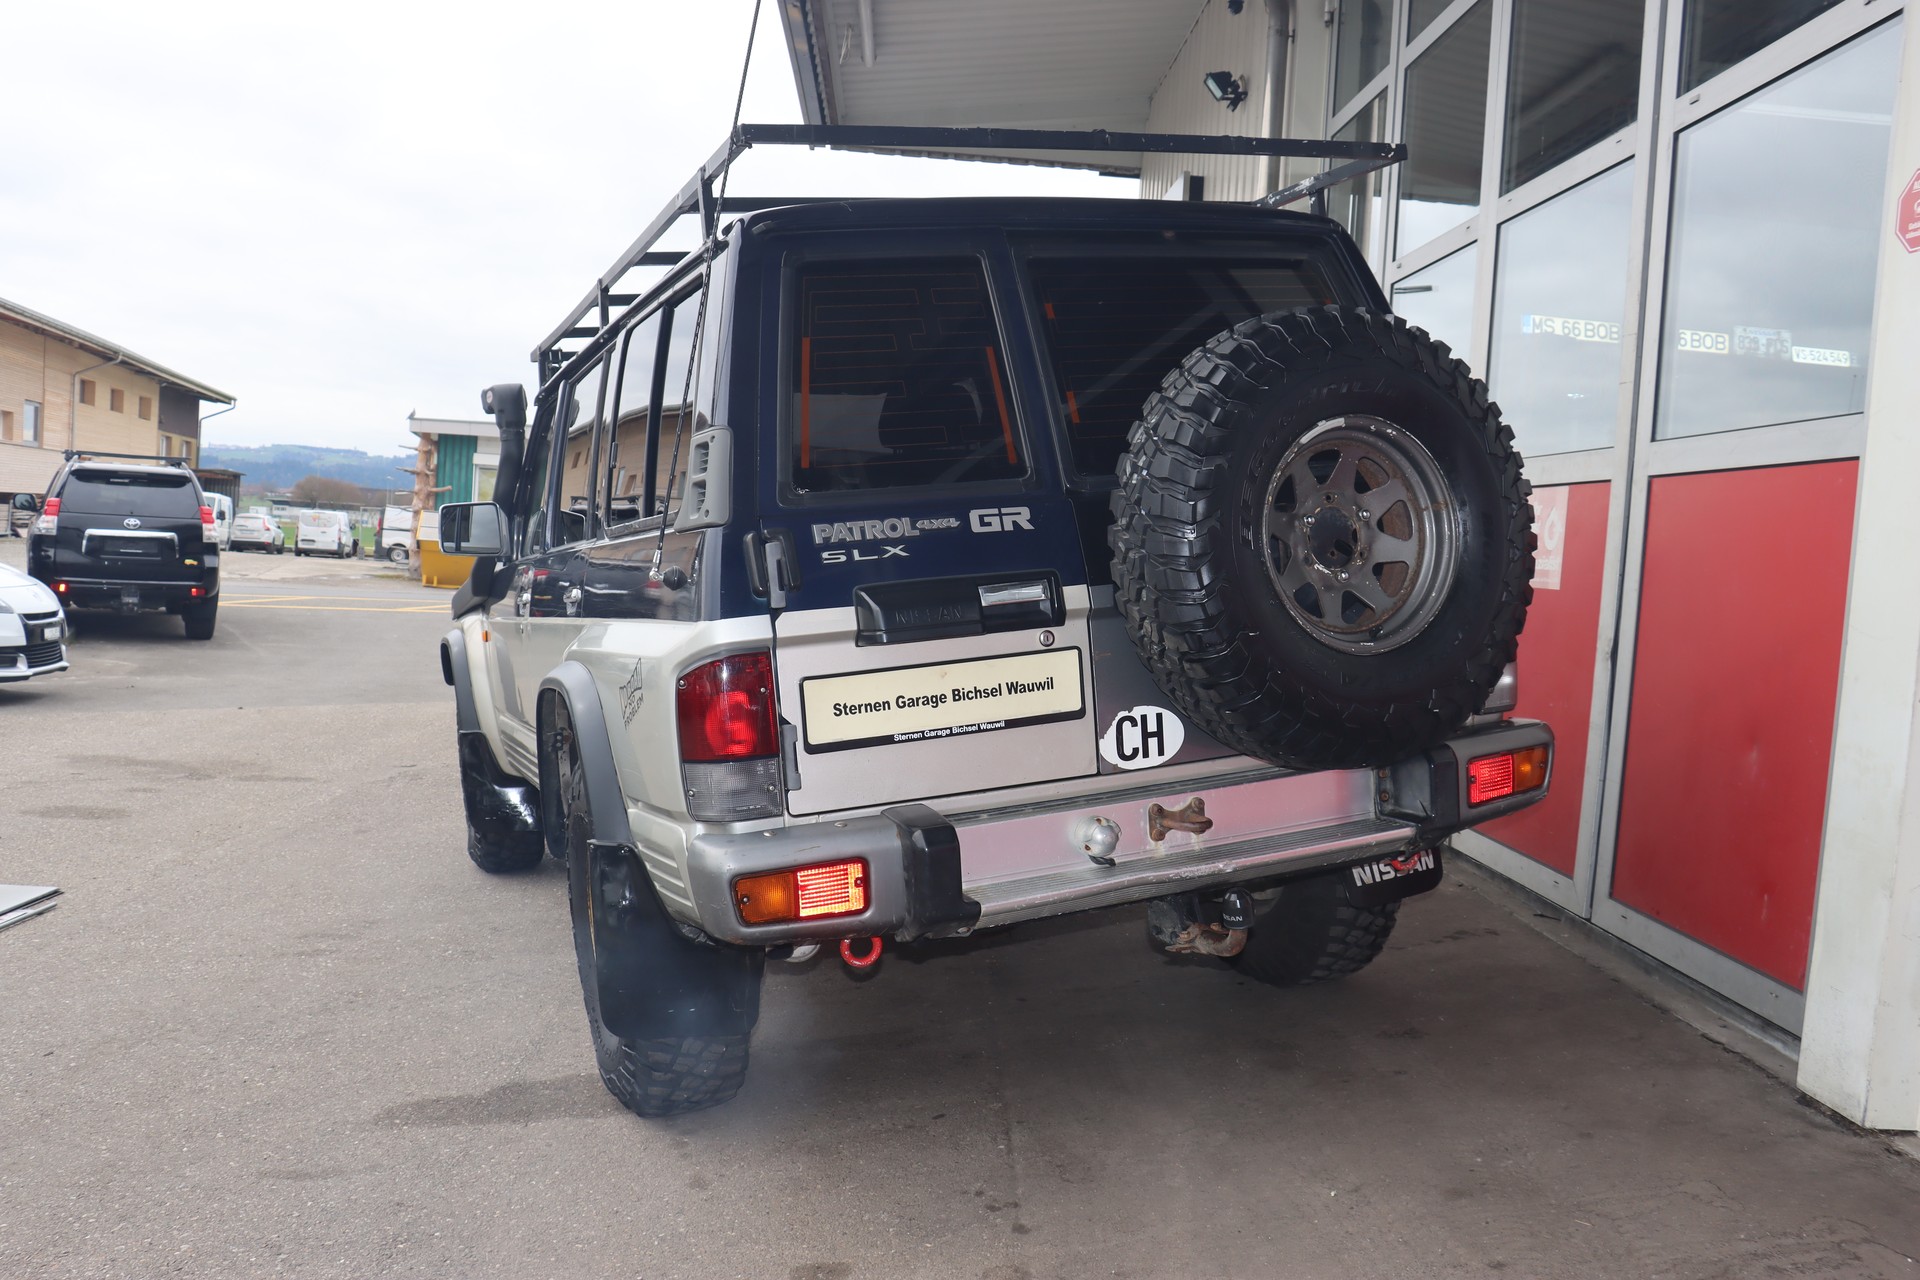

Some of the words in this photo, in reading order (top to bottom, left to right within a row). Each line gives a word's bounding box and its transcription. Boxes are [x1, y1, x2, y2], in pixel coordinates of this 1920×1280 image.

[1532, 316, 1556, 334] MS
[1561, 320, 1582, 337] 66
[1584, 322, 1620, 341] BOB
[1690, 332, 1727, 351] BOB
[812, 517, 920, 545] PATROL
[969, 506, 1035, 533] GR
[821, 544, 910, 564] SLX
[833, 700, 891, 717] Sternen
[895, 693, 947, 709] Garage
[952, 683, 1002, 702] Bichsel
[1005, 677, 1054, 695] Wauwil
[893, 732, 923, 742] Sternen
[924, 729, 951, 738] Garage
[952, 723, 979, 734] Bichsel
[979, 720, 1006, 730] Wauwil
[1115, 711, 1166, 762] CH
